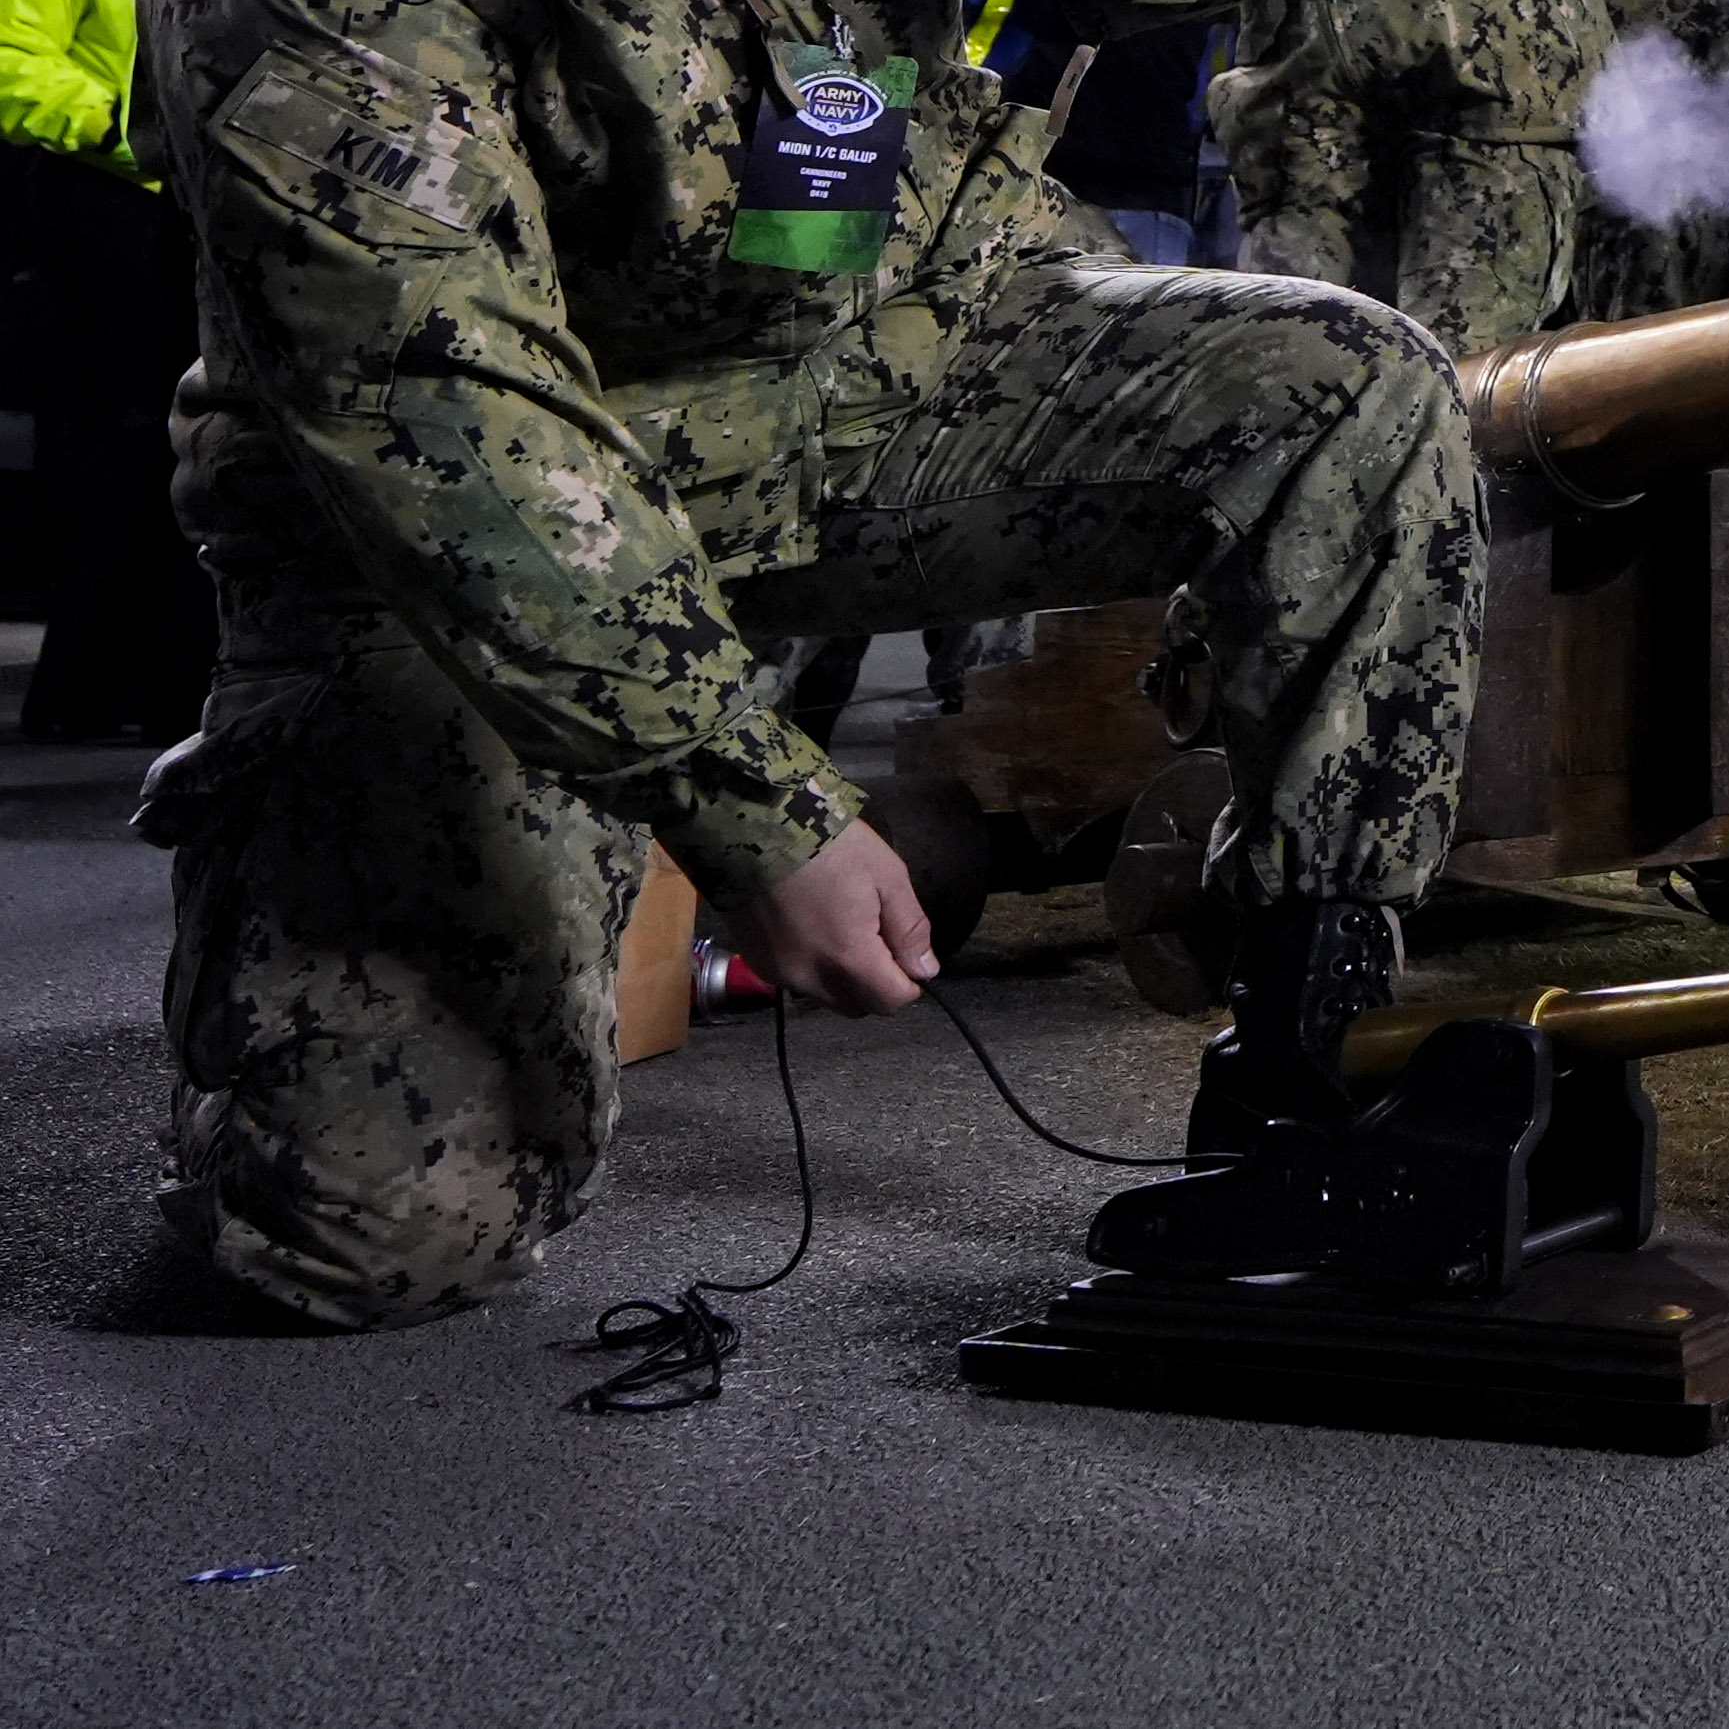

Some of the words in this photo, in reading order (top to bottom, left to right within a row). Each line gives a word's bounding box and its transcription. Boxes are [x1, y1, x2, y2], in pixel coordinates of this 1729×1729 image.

[815, 86, 863, 104] ARMY
[813, 104, 860, 120] NAVY
[323, 126, 422, 191] KIM
[815, 144, 837, 160] 1/C
